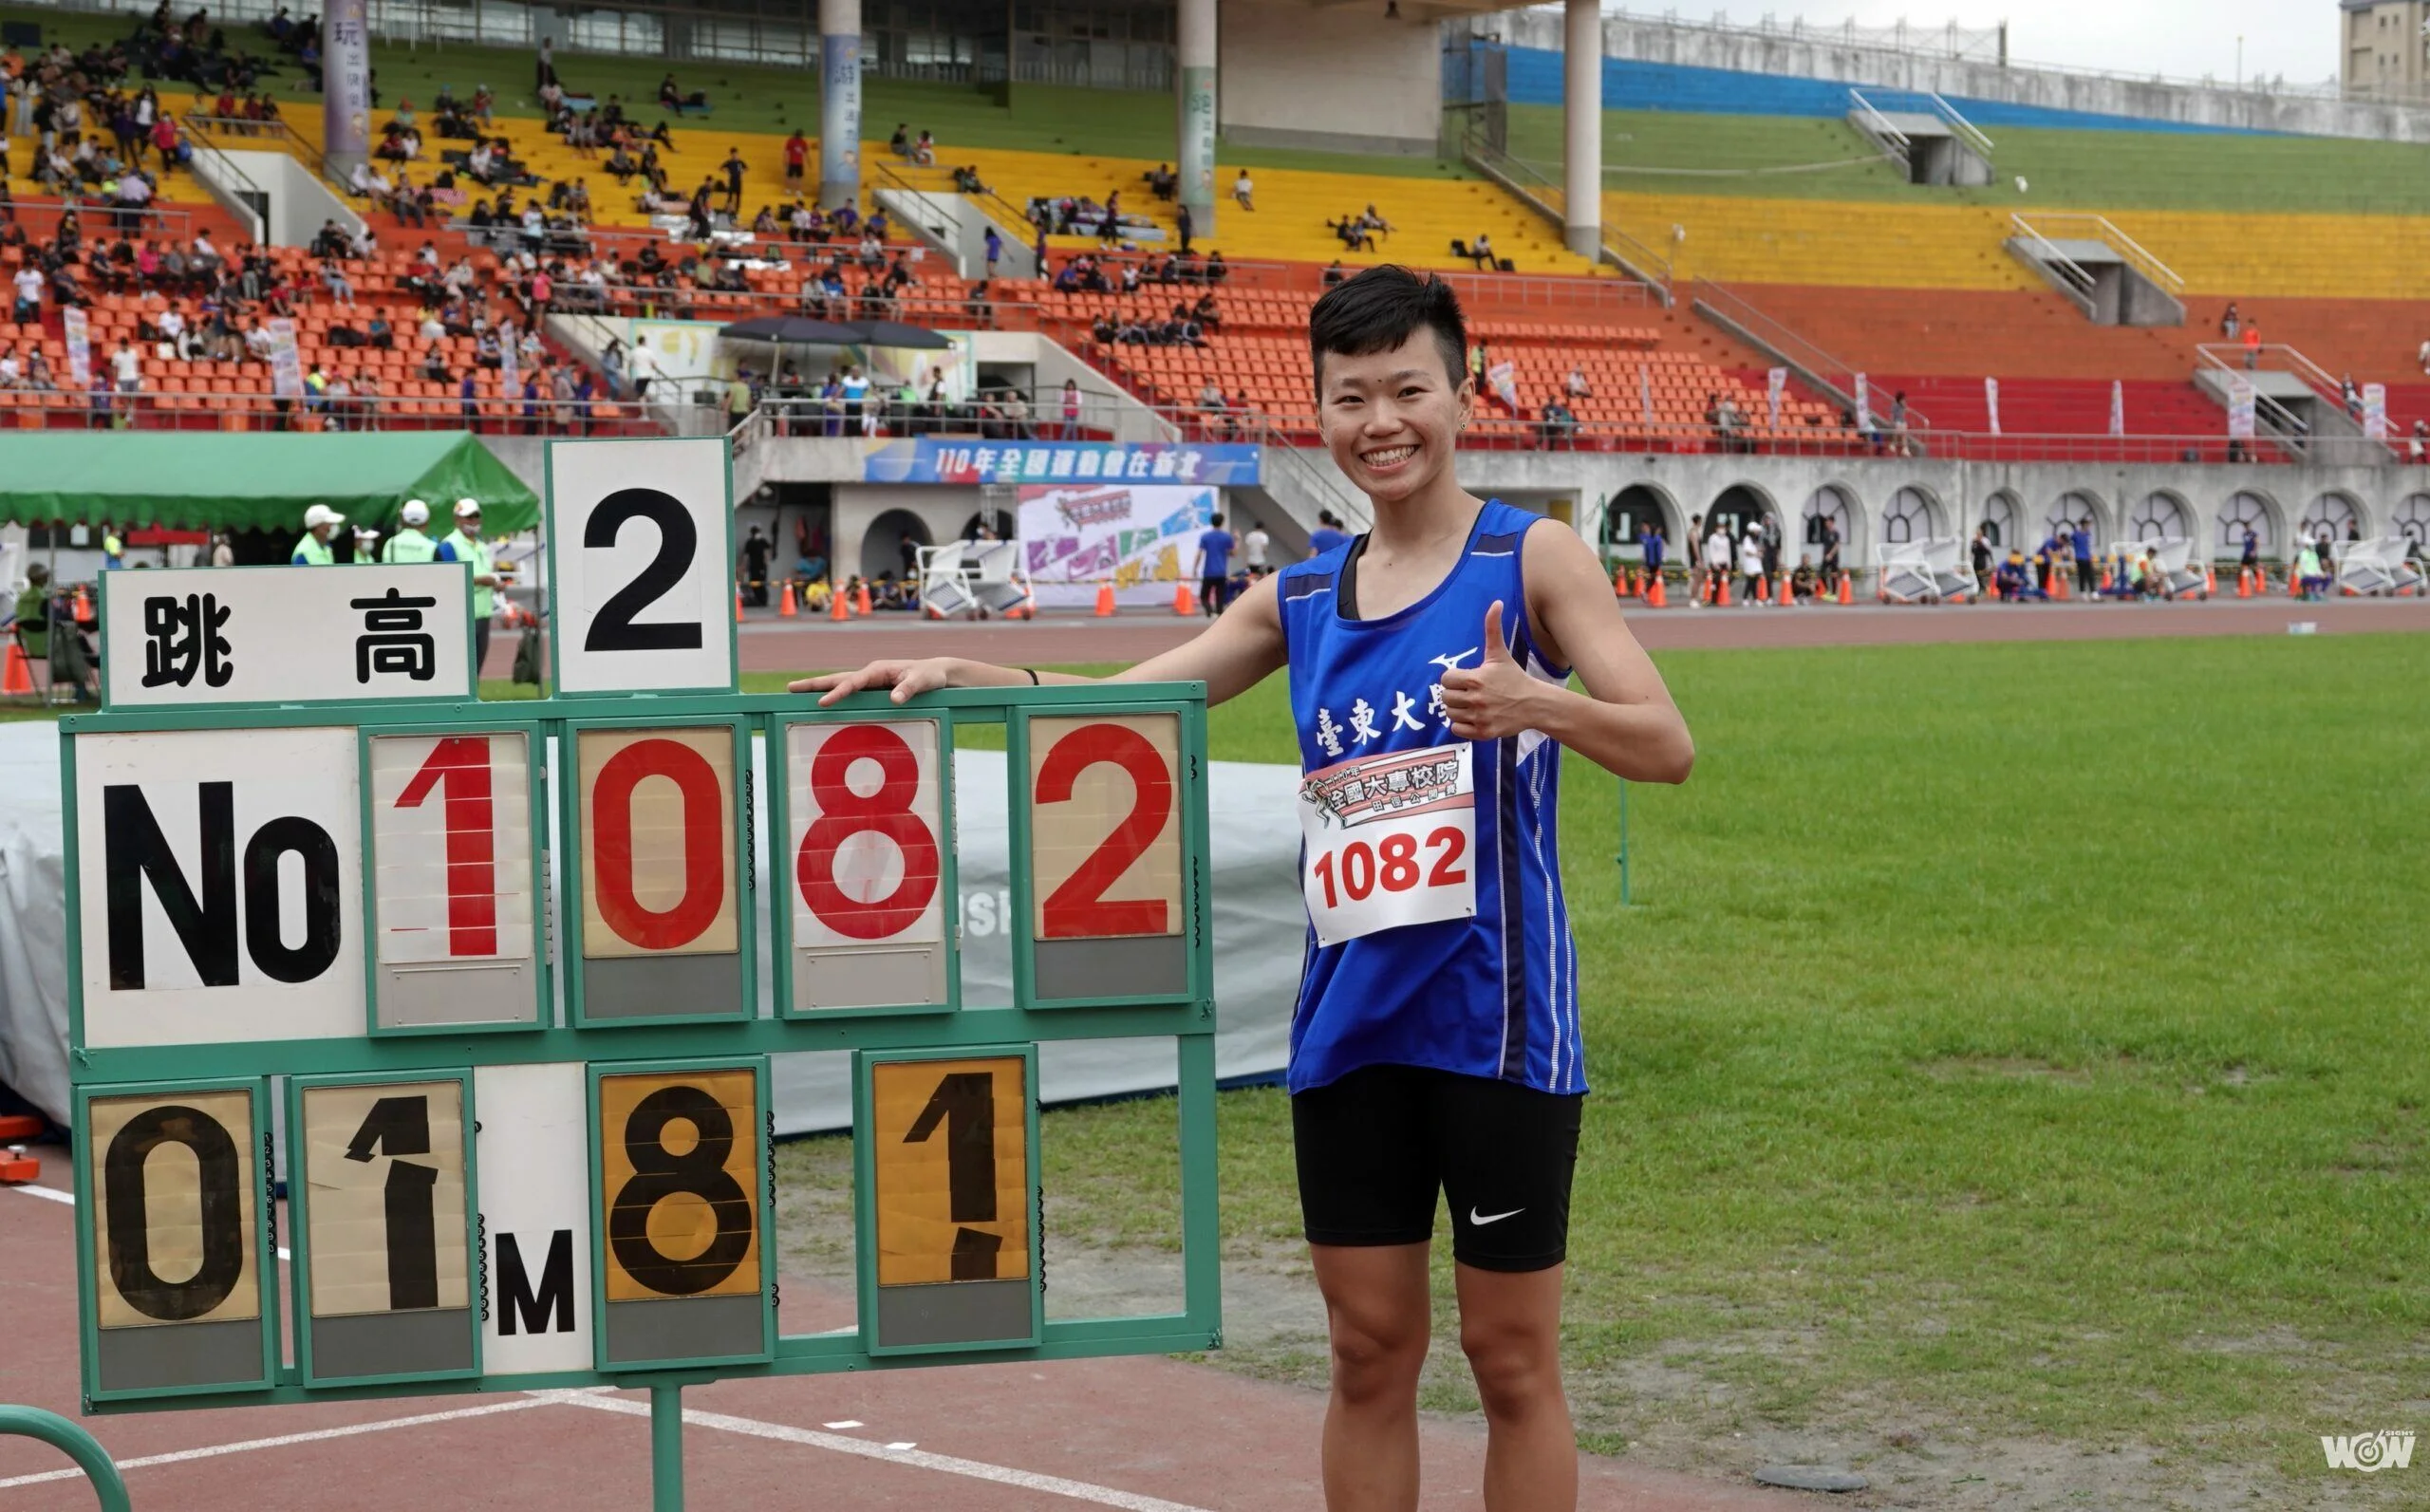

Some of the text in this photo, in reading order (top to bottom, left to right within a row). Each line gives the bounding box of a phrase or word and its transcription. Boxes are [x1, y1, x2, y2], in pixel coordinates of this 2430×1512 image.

[936, 447, 1202, 477] 110年全國運動會在新北
[583, 488, 702, 652] 2
[141, 587, 437, 689] 跳高
[1330, 760, 1460, 811] 全國大專校院
[1372, 784, 1457, 812] 田徑公開賽
[103, 780, 342, 991] No
[1314, 826, 1467, 909] 1082
[495, 1228, 576, 1336] M
